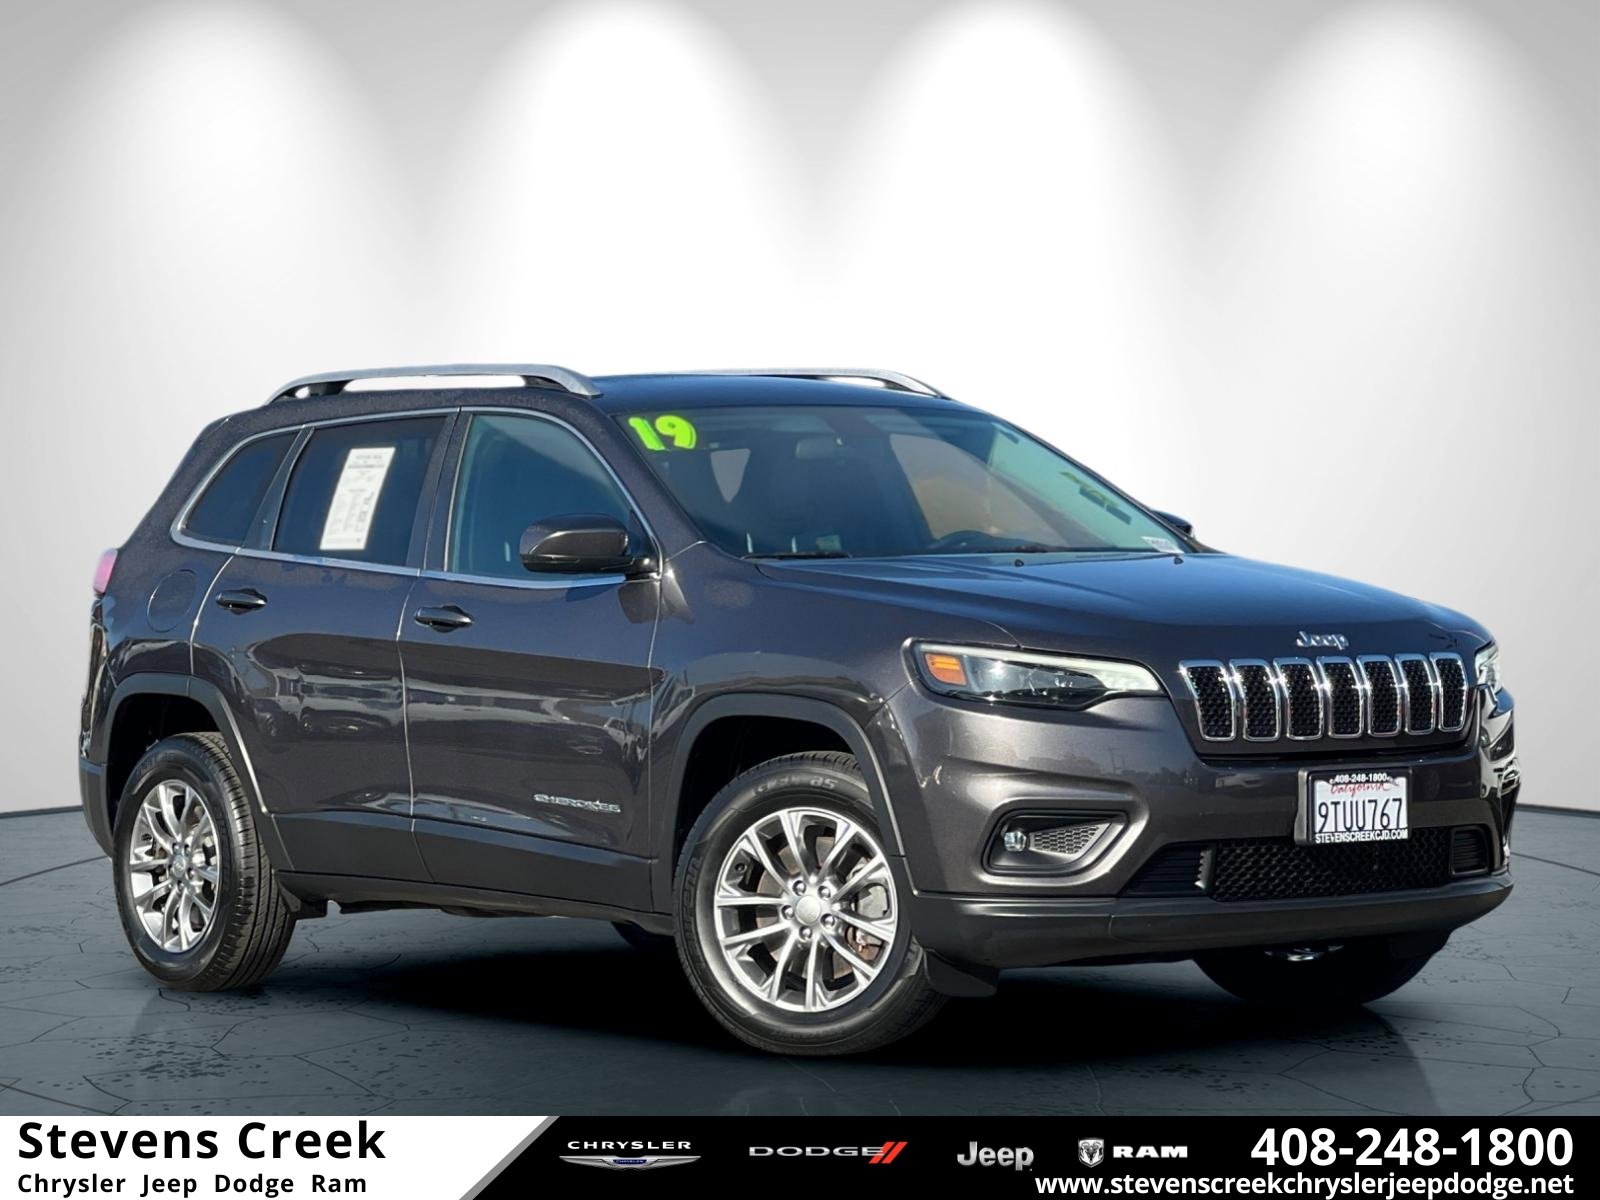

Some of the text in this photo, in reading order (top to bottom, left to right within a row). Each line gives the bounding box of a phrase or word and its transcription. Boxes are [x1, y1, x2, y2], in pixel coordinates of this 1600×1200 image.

[628, 414, 697, 451] 19
[1296, 630, 1349, 650] Jeep
[534, 793, 621, 813] CHEROKEE
[1318, 798, 1403, 833] 9TUU767
[1315, 828, 1409, 844] STEVENSCREEKCJD.COM
